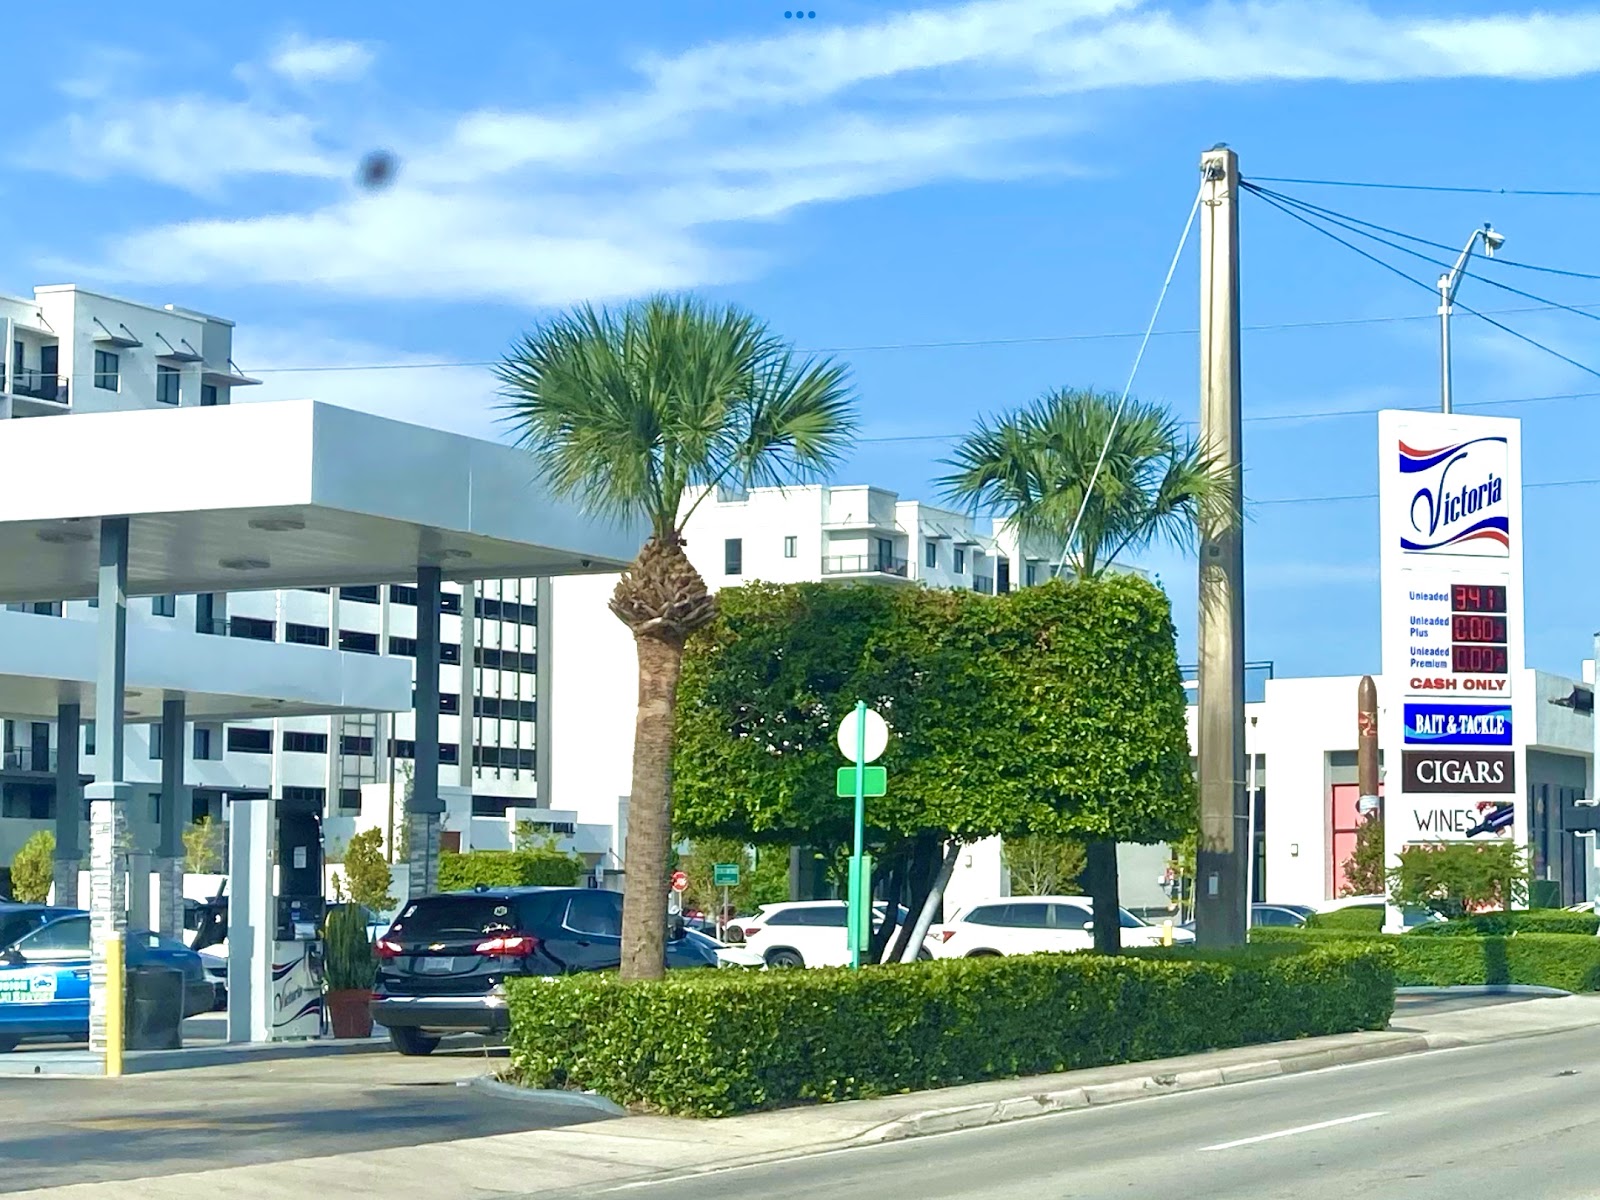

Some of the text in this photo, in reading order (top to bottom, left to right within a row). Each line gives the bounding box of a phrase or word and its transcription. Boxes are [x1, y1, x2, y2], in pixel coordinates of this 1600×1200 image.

[1410, 452, 1502, 537] Victoria
[1408, 591, 1449, 602] Unleaded
[1409, 615, 1450, 626] Unleaded
[1409, 627, 1429, 638] Plus
[1409, 646, 1450, 657] Unleaded
[1409, 658, 1448, 669] Premium
[1409, 678, 1507, 691] CASH ONLY
[1415, 713, 1505, 736] BAIT & TACKLE
[1415, 759, 1504, 784] CIGARS
[1413, 808, 1478, 833] WINES
